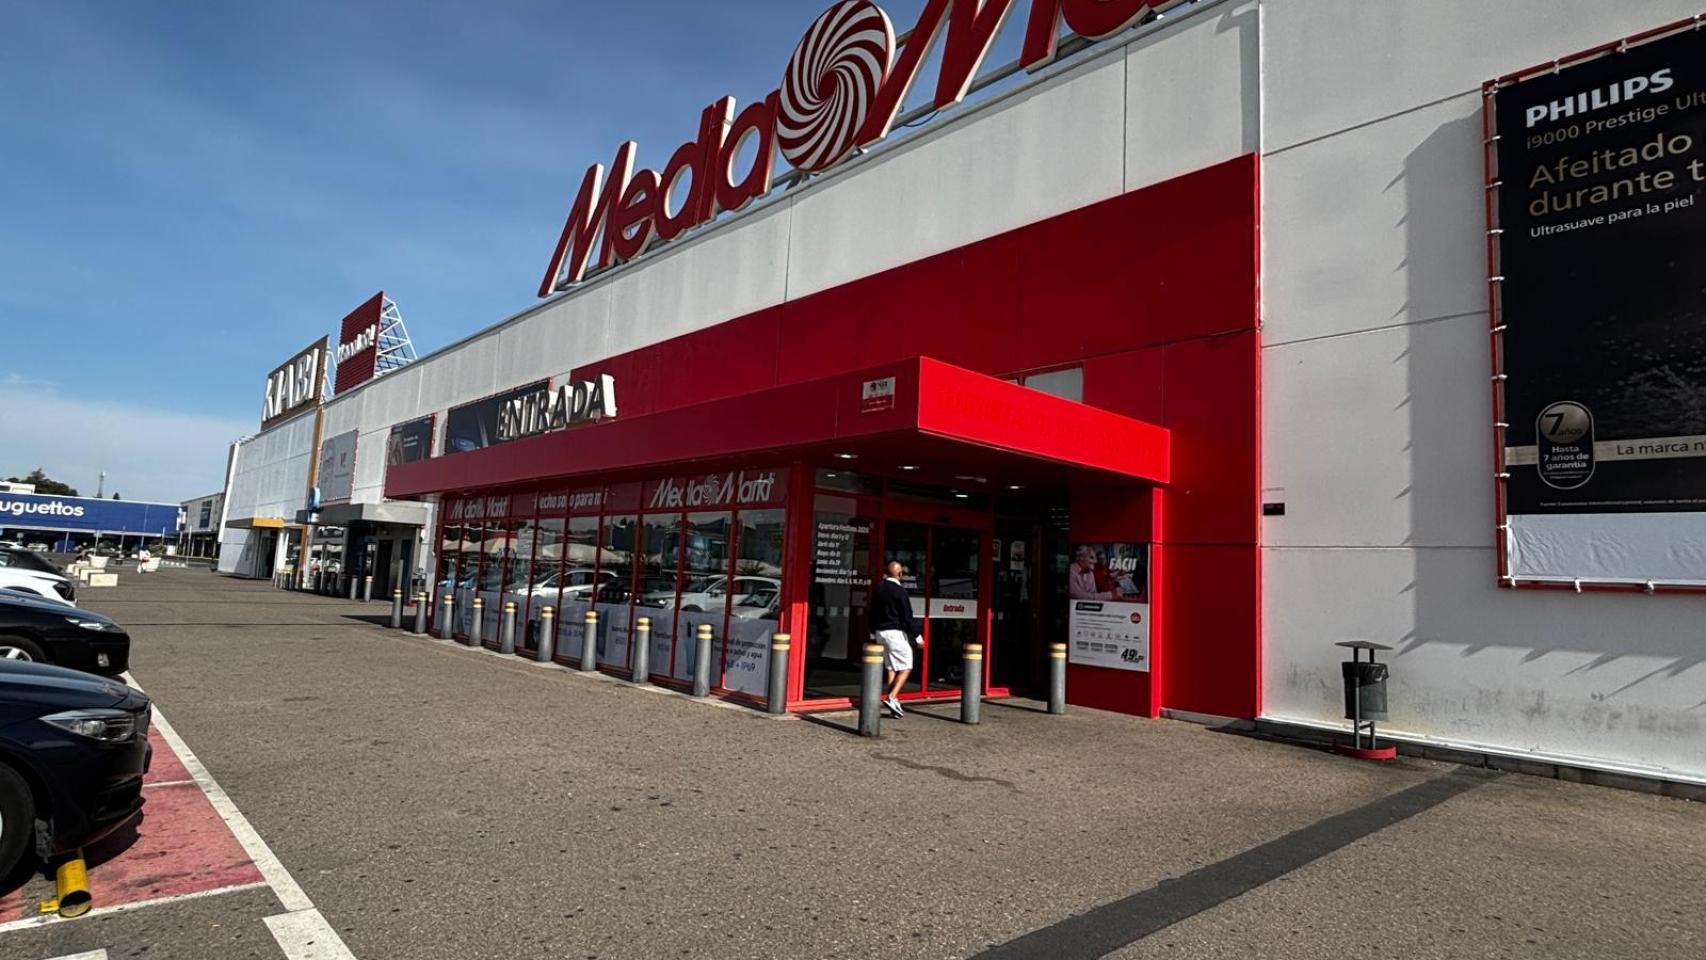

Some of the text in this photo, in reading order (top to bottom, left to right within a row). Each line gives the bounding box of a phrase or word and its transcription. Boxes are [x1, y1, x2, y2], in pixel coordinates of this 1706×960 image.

[1525, 68, 1674, 128] PHILIPS
[1526, 125, 1580, 149] i9000
[1585, 104, 1669, 134] Prestige
[1529, 133, 1693, 189] Afeitado
[538, 90, 782, 297] Media
[1528, 169, 1675, 217] durante
[1530, 194, 1694, 238] Ultrasuave para la piel
[497, 373, 617, 440] ENTRADA
[1545, 412, 1564, 436] 7
[1543, 452, 1590, 462] 7 años de
[1551, 445, 1580, 453] Hasta
[1616, 444, 1634, 456] La
[1639, 442, 1689, 454] marca
[0, 500, 85, 517] uguettos
